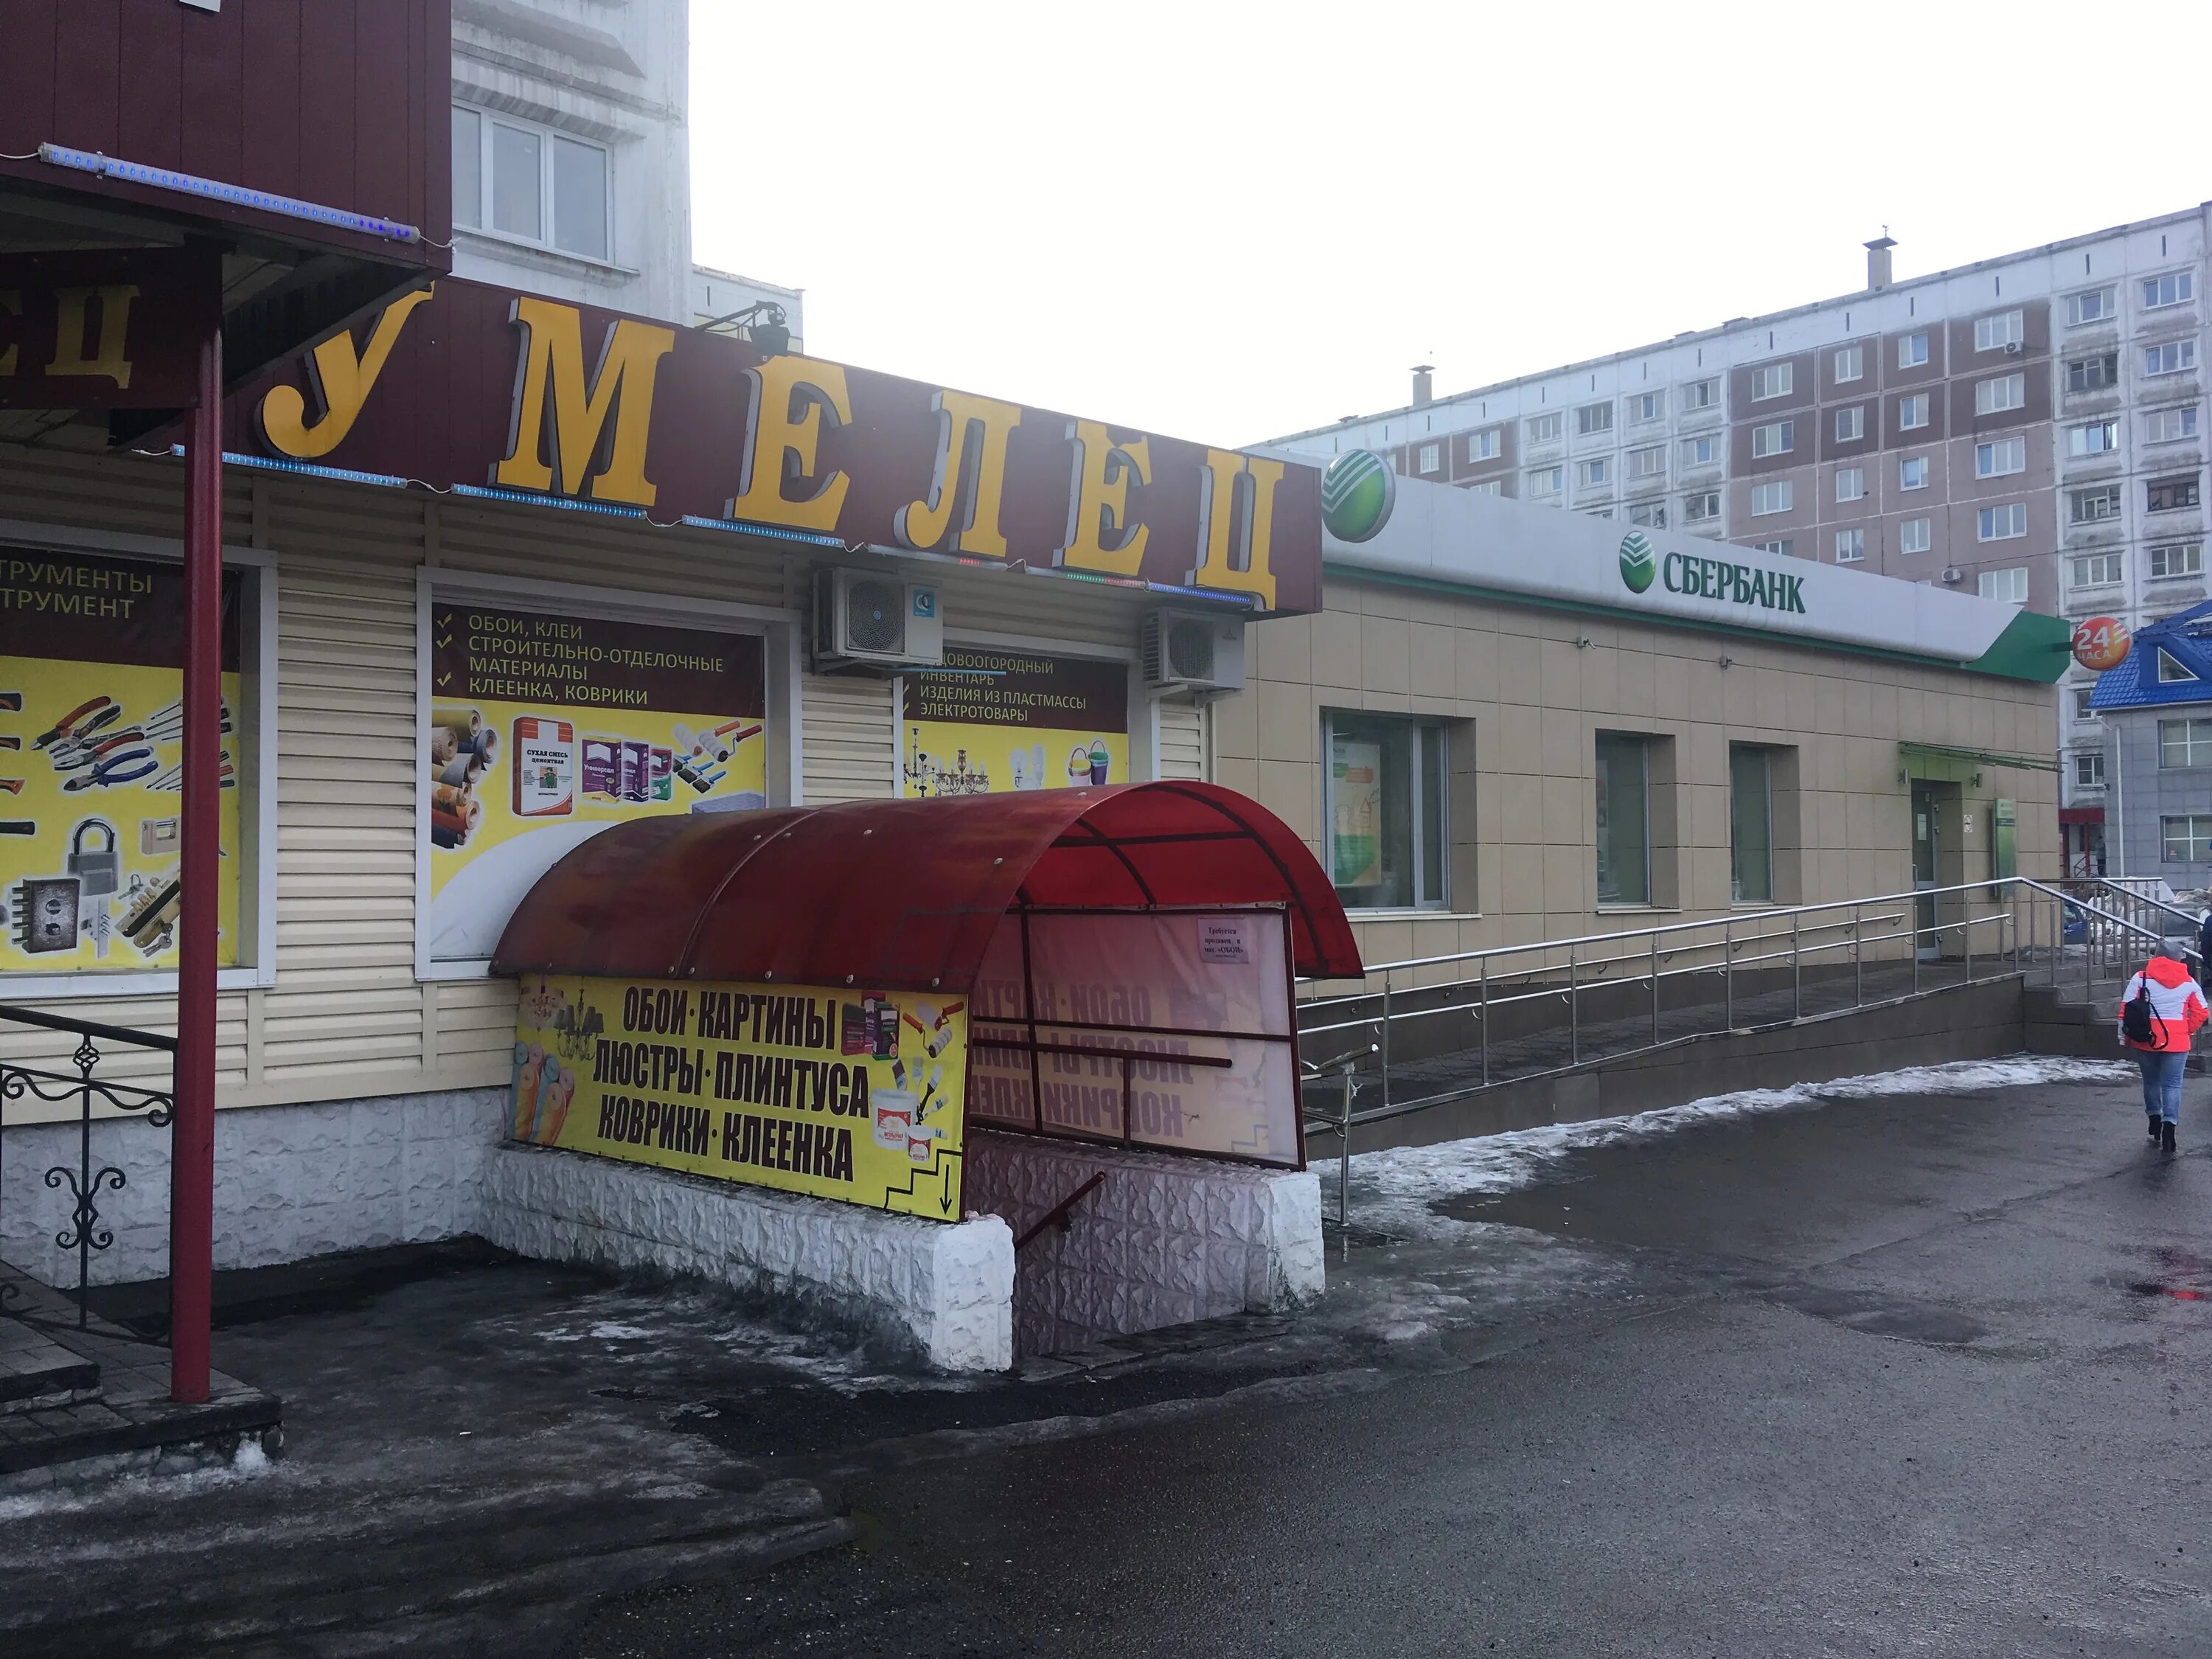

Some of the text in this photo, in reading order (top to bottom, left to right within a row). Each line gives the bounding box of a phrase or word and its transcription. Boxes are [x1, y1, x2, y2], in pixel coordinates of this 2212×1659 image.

[255, 280, 1284, 612] УМЕЛЕЦ
[1663, 552, 1806, 613] СБЕРБАНК
[468, 615, 529, 637] ОБОИ,
[2077, 625, 2110, 650] 24
[468, 636, 723, 672] СТРОИТЕЛЬНО-ОТДЕЛОЧНЫЕ
[2078, 649, 2112, 661] ЧАСА
[469, 656, 588, 681] МАТЕРИАЛЫ
[469, 677, 648, 705] КЛЕЕНКА, КОВРИКИ
[920, 684, 1086, 709] ИЗДЕЛИЯ ИЗ ПЛАСТМАССЫ
[920, 702, 1028, 722] ЭЛЕКТРОТОВАРЫ
[623, 986, 688, 1035] ОБОИ
[698, 991, 835, 1050] КАРТИНЫ
[593, 1039, 869, 1119] ЛЮСТРЫ ПЛИНТУСА
[597, 1094, 854, 1182] КОВРИКИ КЛЕЕНКА
